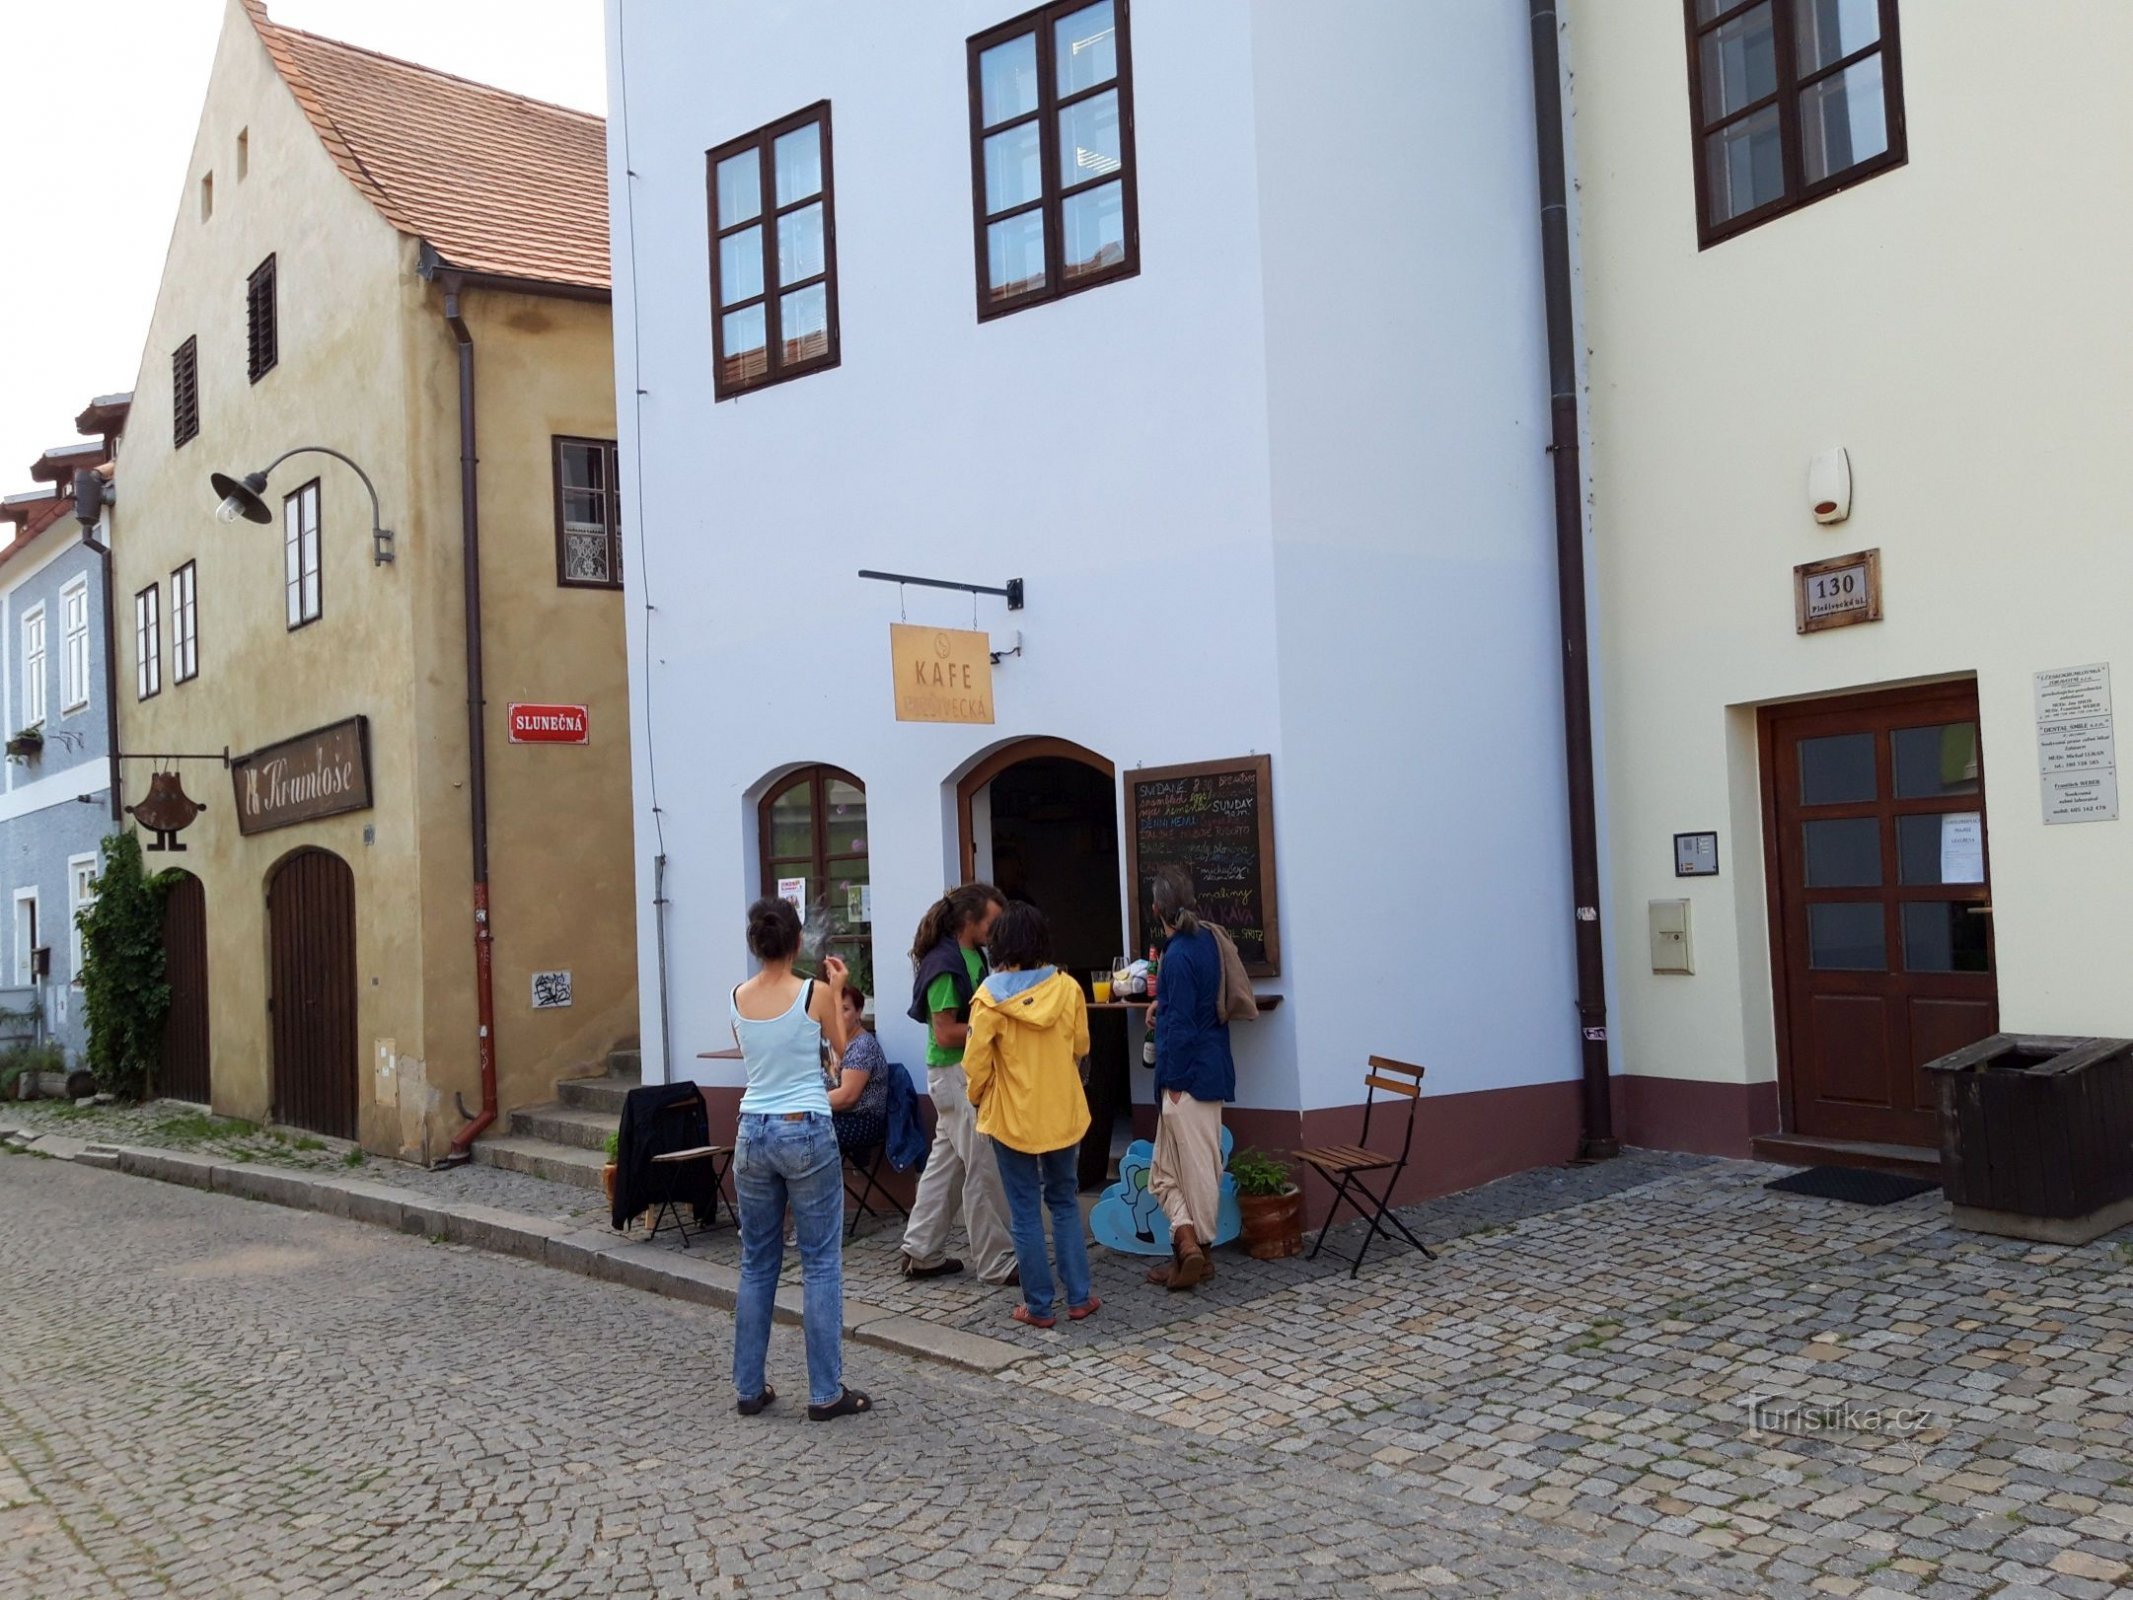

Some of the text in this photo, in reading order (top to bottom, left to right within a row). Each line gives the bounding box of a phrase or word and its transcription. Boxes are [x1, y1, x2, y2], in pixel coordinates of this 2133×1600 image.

[1816, 575, 1854, 598] 130
[915, 660, 972, 689] KAFE
[516, 713, 582, 731] SLUNEČNÁ
[1212, 798, 1253, 813] SUNDAY
